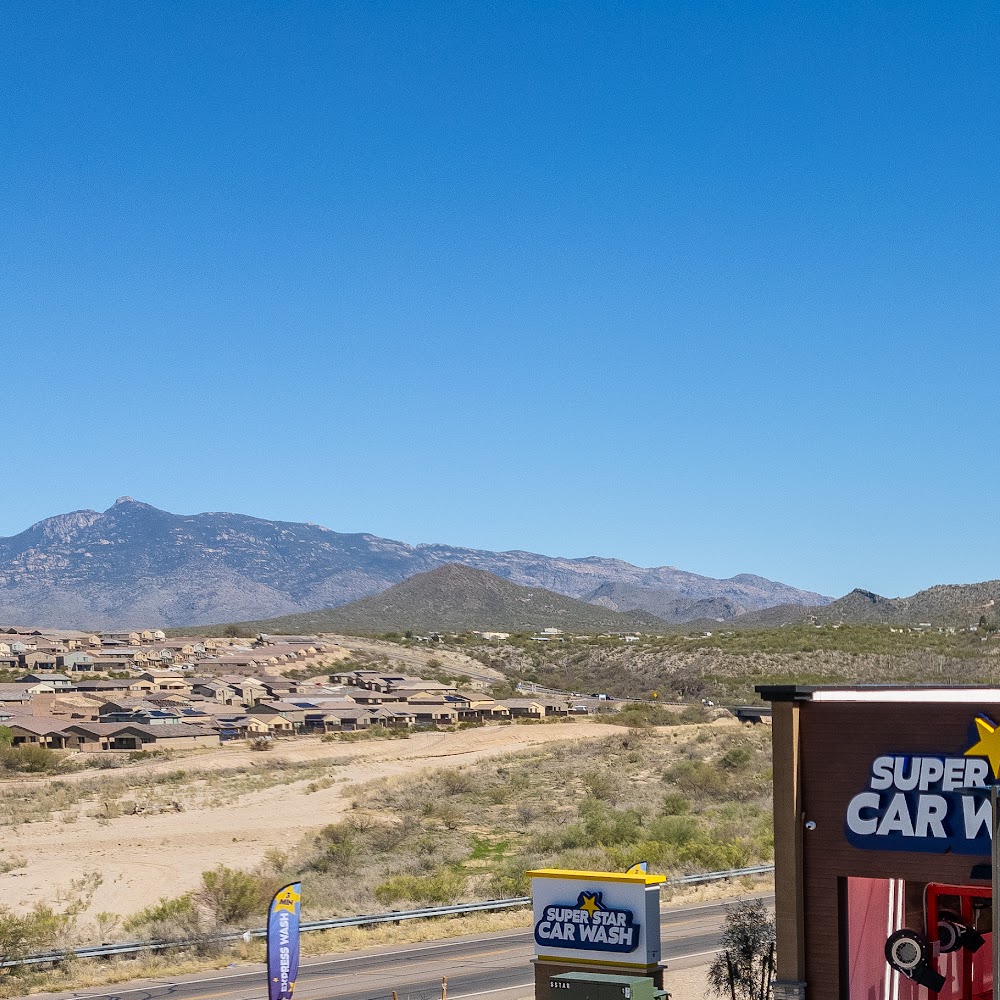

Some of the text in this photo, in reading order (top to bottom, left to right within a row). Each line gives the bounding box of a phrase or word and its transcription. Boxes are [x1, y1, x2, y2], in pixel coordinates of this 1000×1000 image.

[871, 756, 988, 792] SUPER
[846, 792, 947, 838] CAR
[279, 912, 289, 945] WASH
[538, 921, 633, 946] CAR WASH
[546, 908, 626, 927] SUPER STAR
[280, 947, 290, 992] EXPRESS
